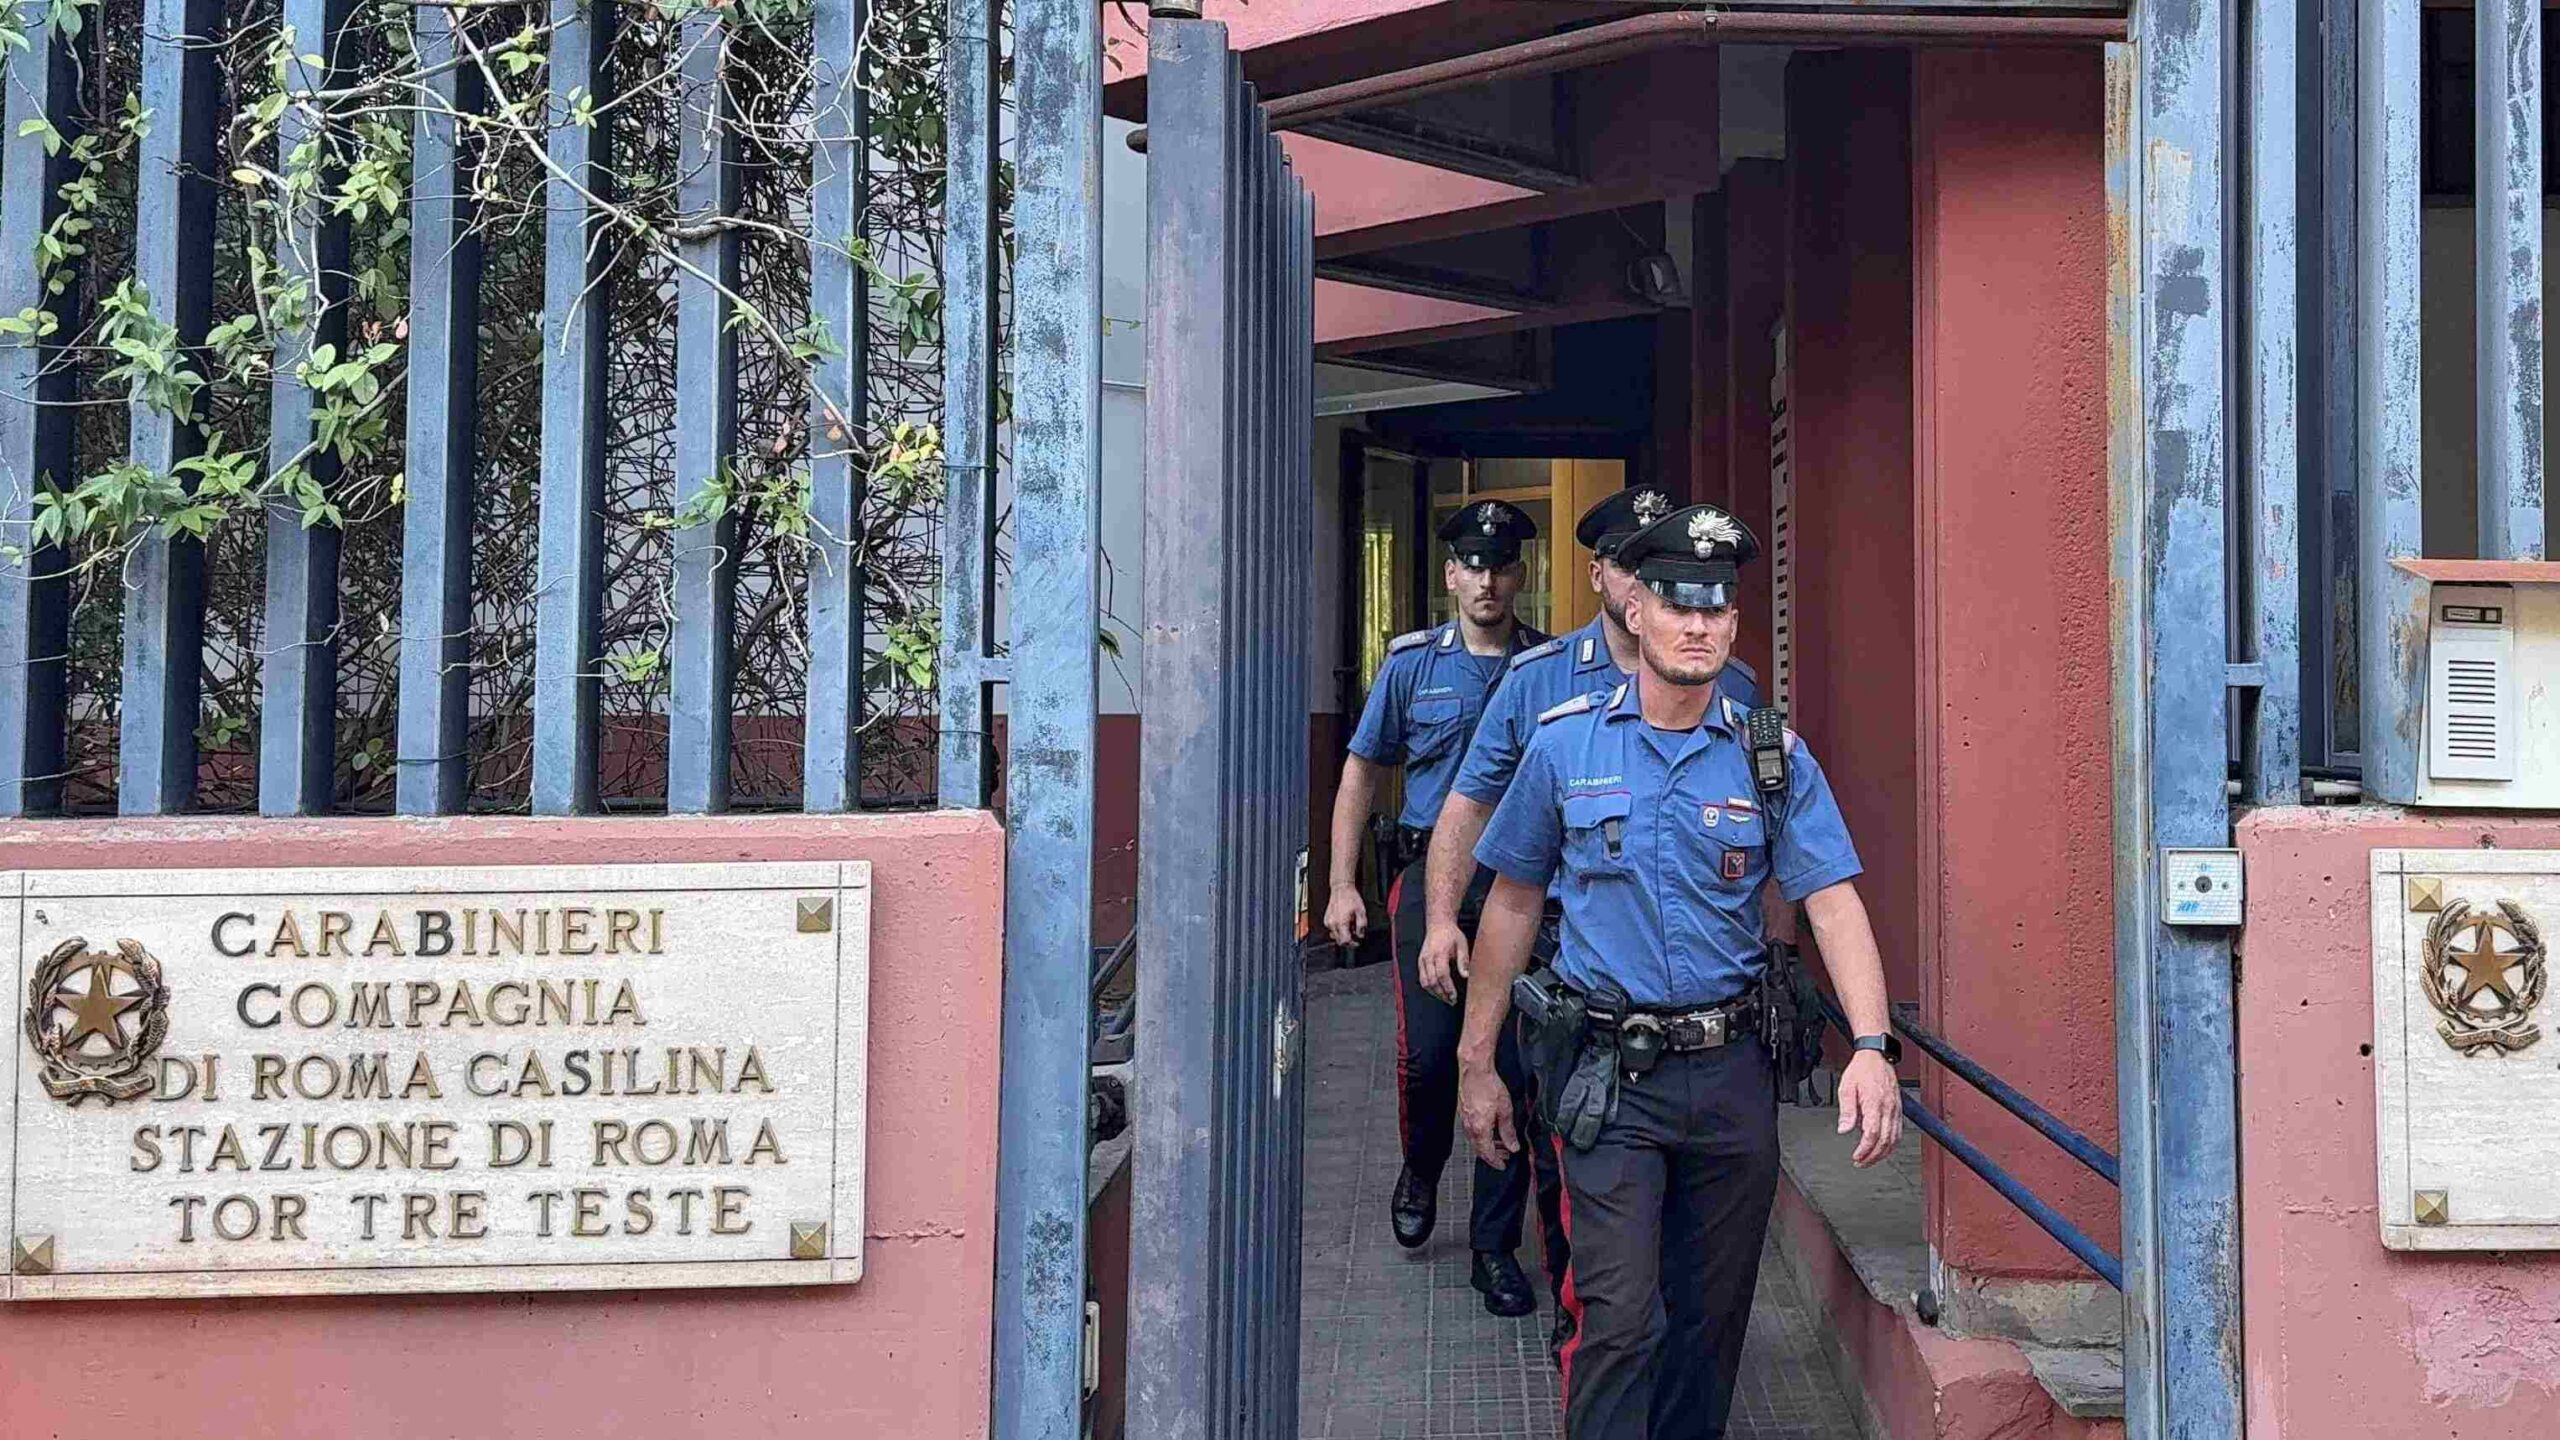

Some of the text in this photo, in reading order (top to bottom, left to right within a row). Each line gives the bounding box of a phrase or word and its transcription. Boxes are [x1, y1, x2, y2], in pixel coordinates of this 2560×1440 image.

[211, 908, 664, 958] CARABINIERI
[236, 977, 647, 1030] COMPAGNIA
[151, 1054, 218, 1102] DI
[252, 1051, 442, 1100] ROMA
[465, 1045, 775, 1097] CASILINA
[130, 1117, 787, 1173] STAZIONE DI ROMA
[169, 1185, 753, 1243] TOR TRE TESTE
